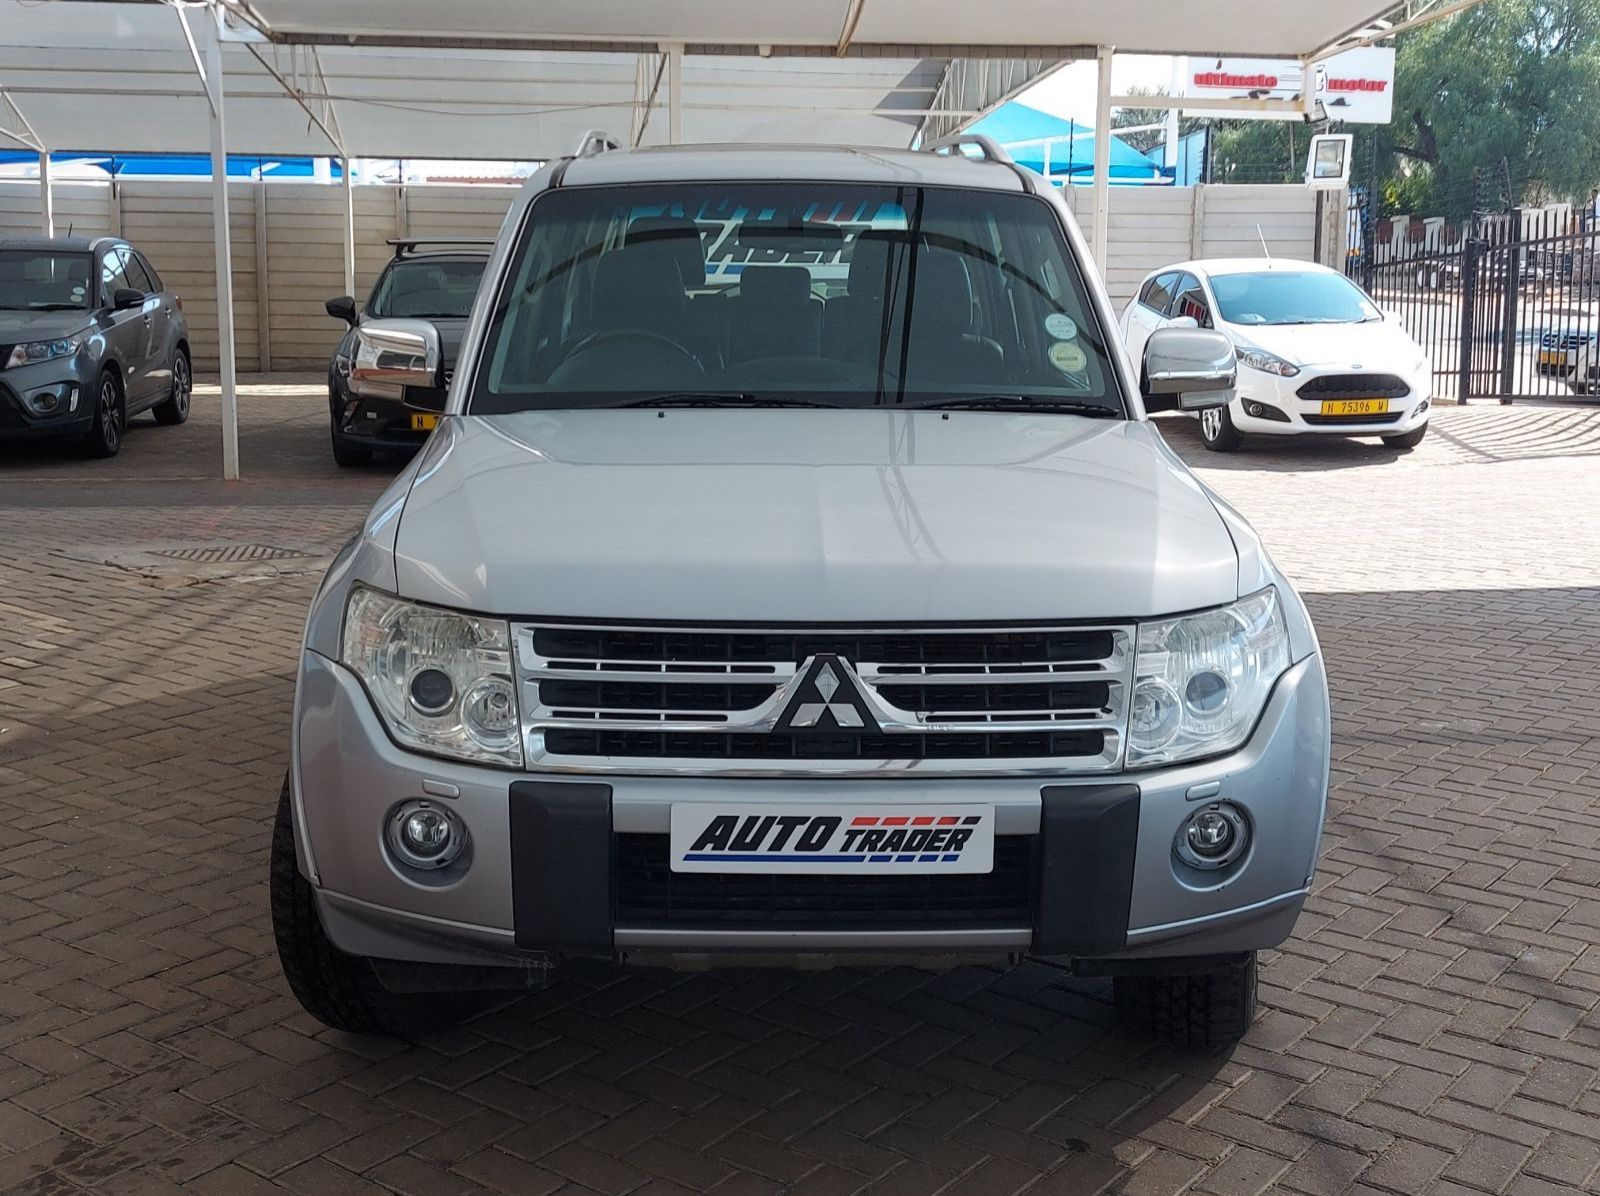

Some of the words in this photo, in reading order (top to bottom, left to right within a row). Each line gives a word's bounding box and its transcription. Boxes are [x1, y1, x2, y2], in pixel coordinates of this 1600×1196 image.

[1327, 78, 1387, 91] motor
[1328, 403, 1334, 413] N
[1341, 401, 1370, 412] 75396
[416, 415, 424, 428] N
[689, 815, 843, 852] AUTO
[839, 828, 974, 853] TRADER
